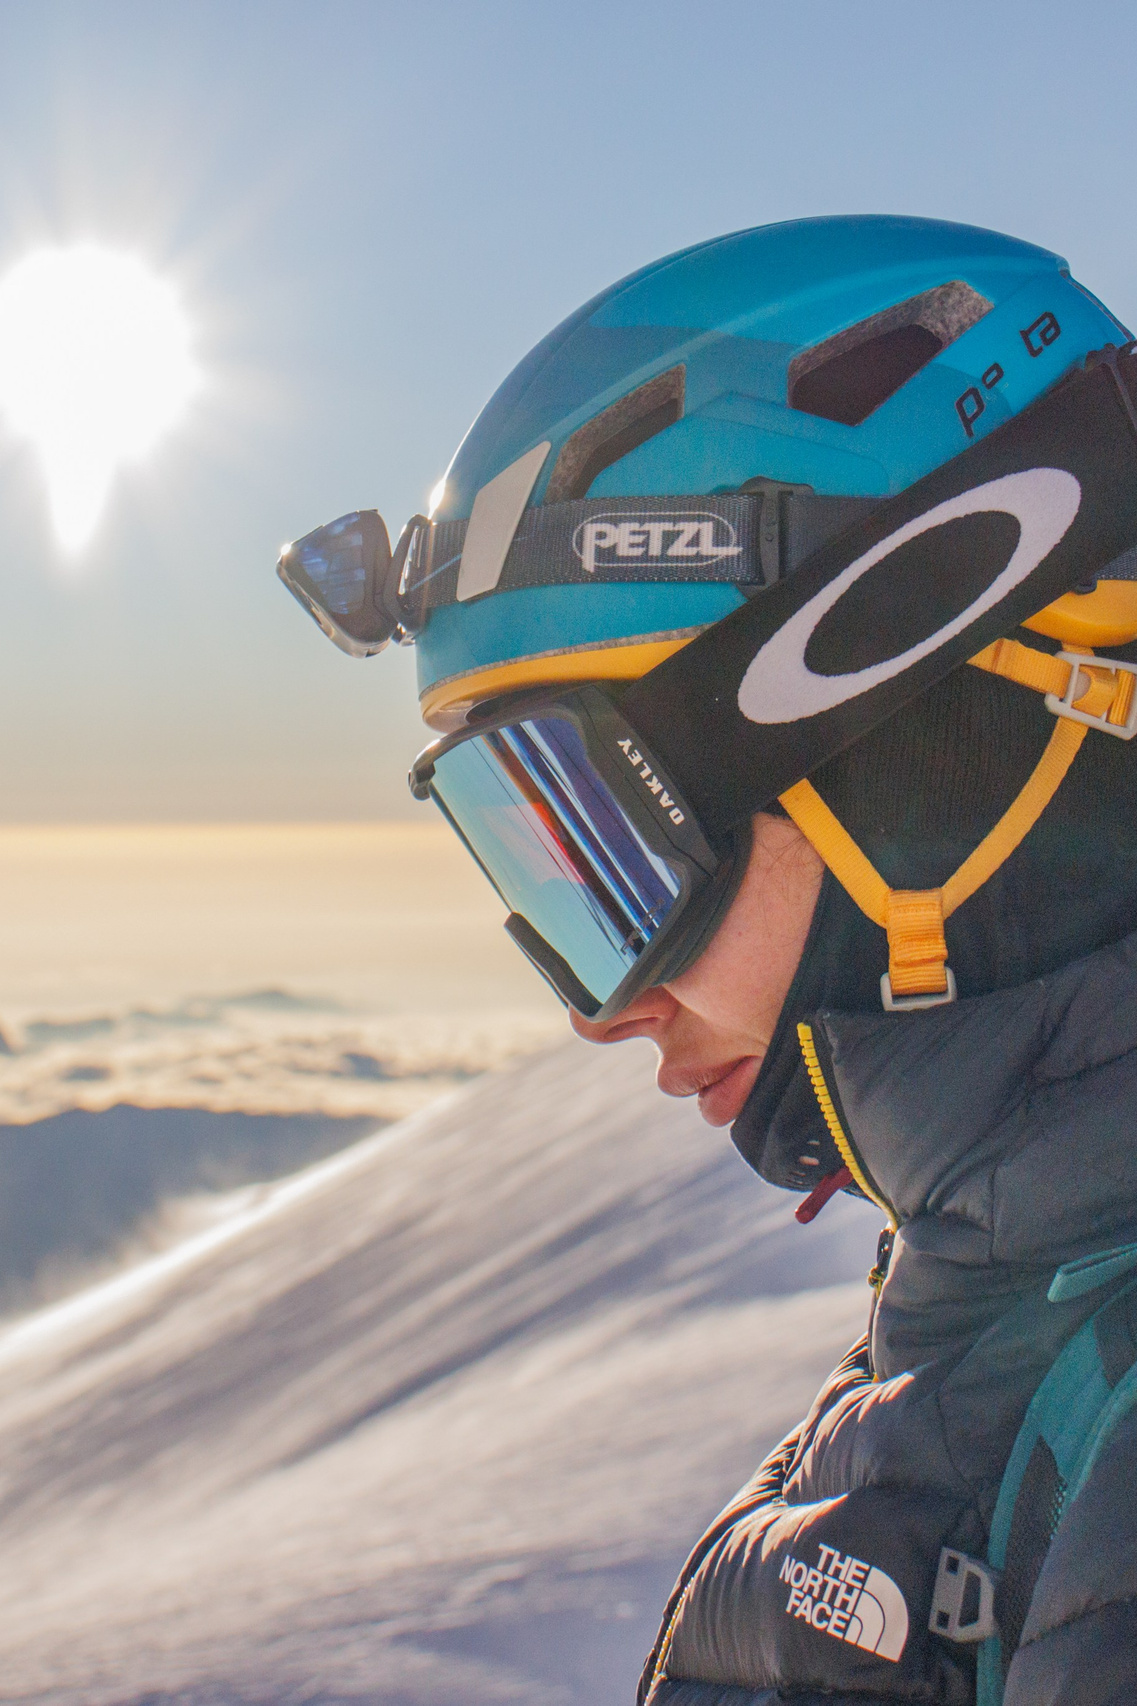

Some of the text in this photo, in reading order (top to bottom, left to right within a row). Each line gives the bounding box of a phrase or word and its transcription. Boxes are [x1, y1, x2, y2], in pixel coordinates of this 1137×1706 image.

[582, 521, 743, 573] PETZL
[617, 738, 685, 825] OAKLEY
[779, 1554, 861, 1615] NORTH
[817, 1542, 870, 1590] THE
[785, 1587, 852, 1640] FACE
